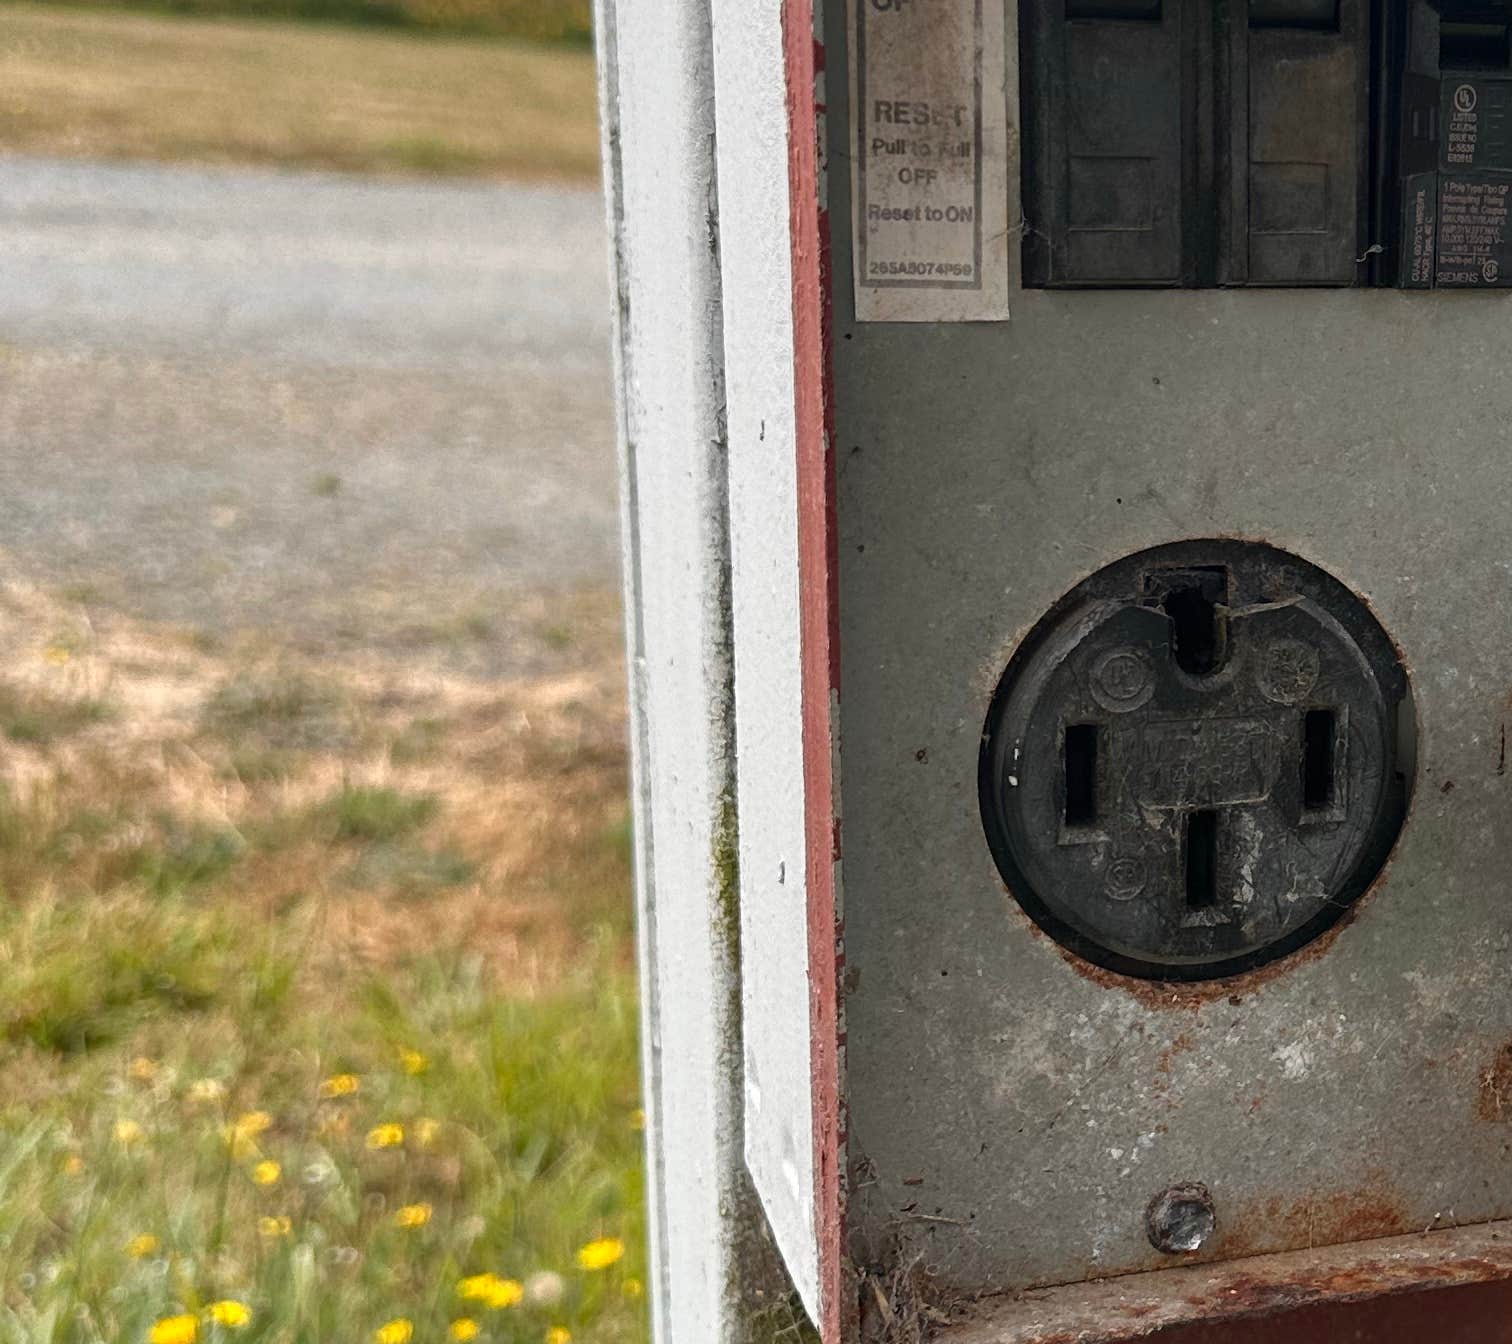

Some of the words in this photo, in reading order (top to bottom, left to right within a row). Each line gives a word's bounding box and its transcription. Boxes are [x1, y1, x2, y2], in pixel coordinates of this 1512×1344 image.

[873, 99, 968, 127] RESET
[872, 138, 906, 156] Pull
[911, 141, 931, 156] to
[898, 167, 938, 186] OFF
[867, 204, 921, 222] Reset
[925, 205, 943, 222] to
[945, 206, 973, 223] ON
